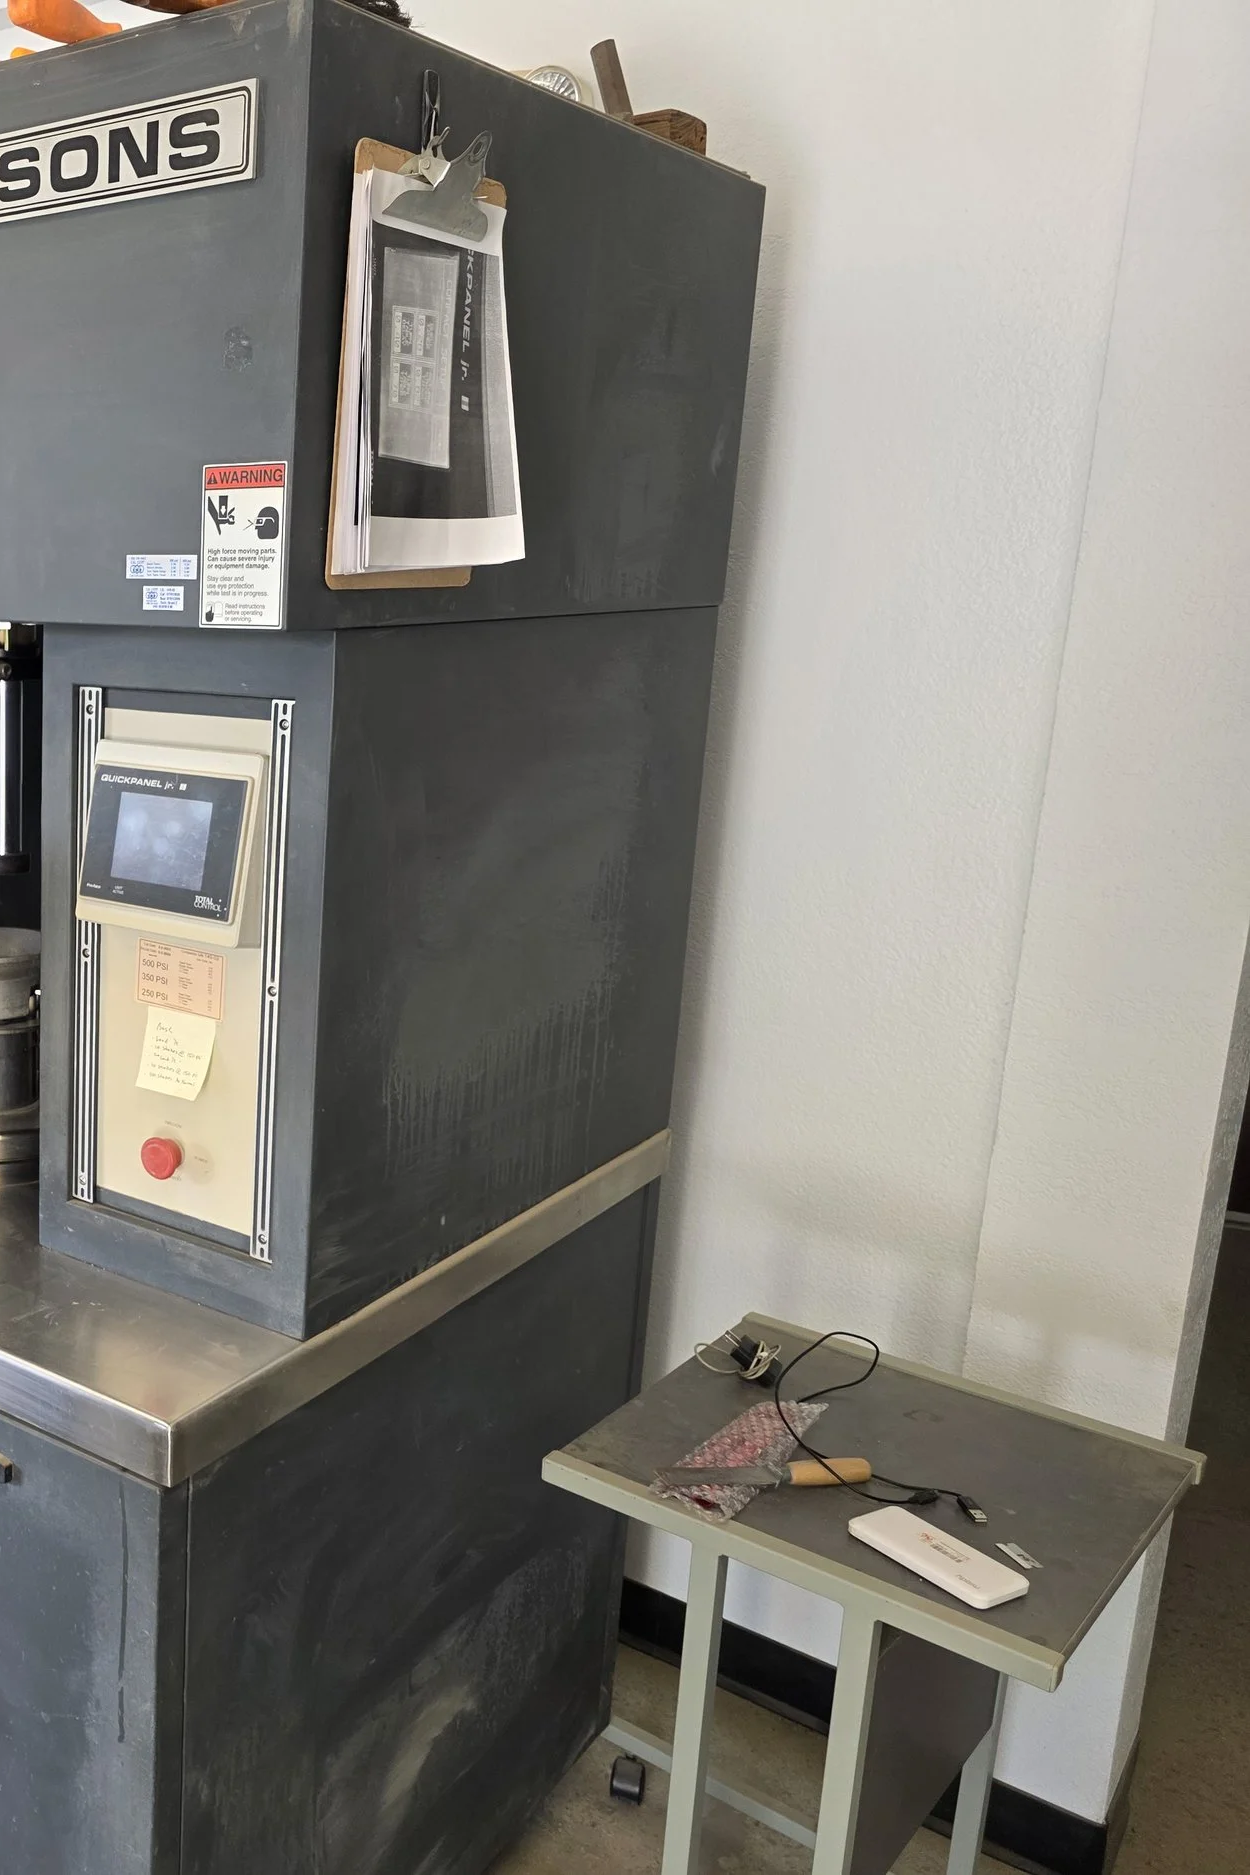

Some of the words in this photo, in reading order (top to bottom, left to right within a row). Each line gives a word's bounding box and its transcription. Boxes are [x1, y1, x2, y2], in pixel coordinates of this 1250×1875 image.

[219, 469, 283, 484] WARNING
[207, 548, 220, 556] High
[100, 773, 162, 788] QUICKPANEL
[164, 781, 174, 790] jr.
[193, 900, 222, 912] CONTROL
[195, 895, 213, 905] TOTAL
[142, 959, 154, 968] 500
[156, 961, 168, 971] PSI
[142, 972, 154, 982] 350
[156, 976, 168, 985] PSI
[142, 988, 154, 998] 250
[156, 992, 168, 1000] PSI
